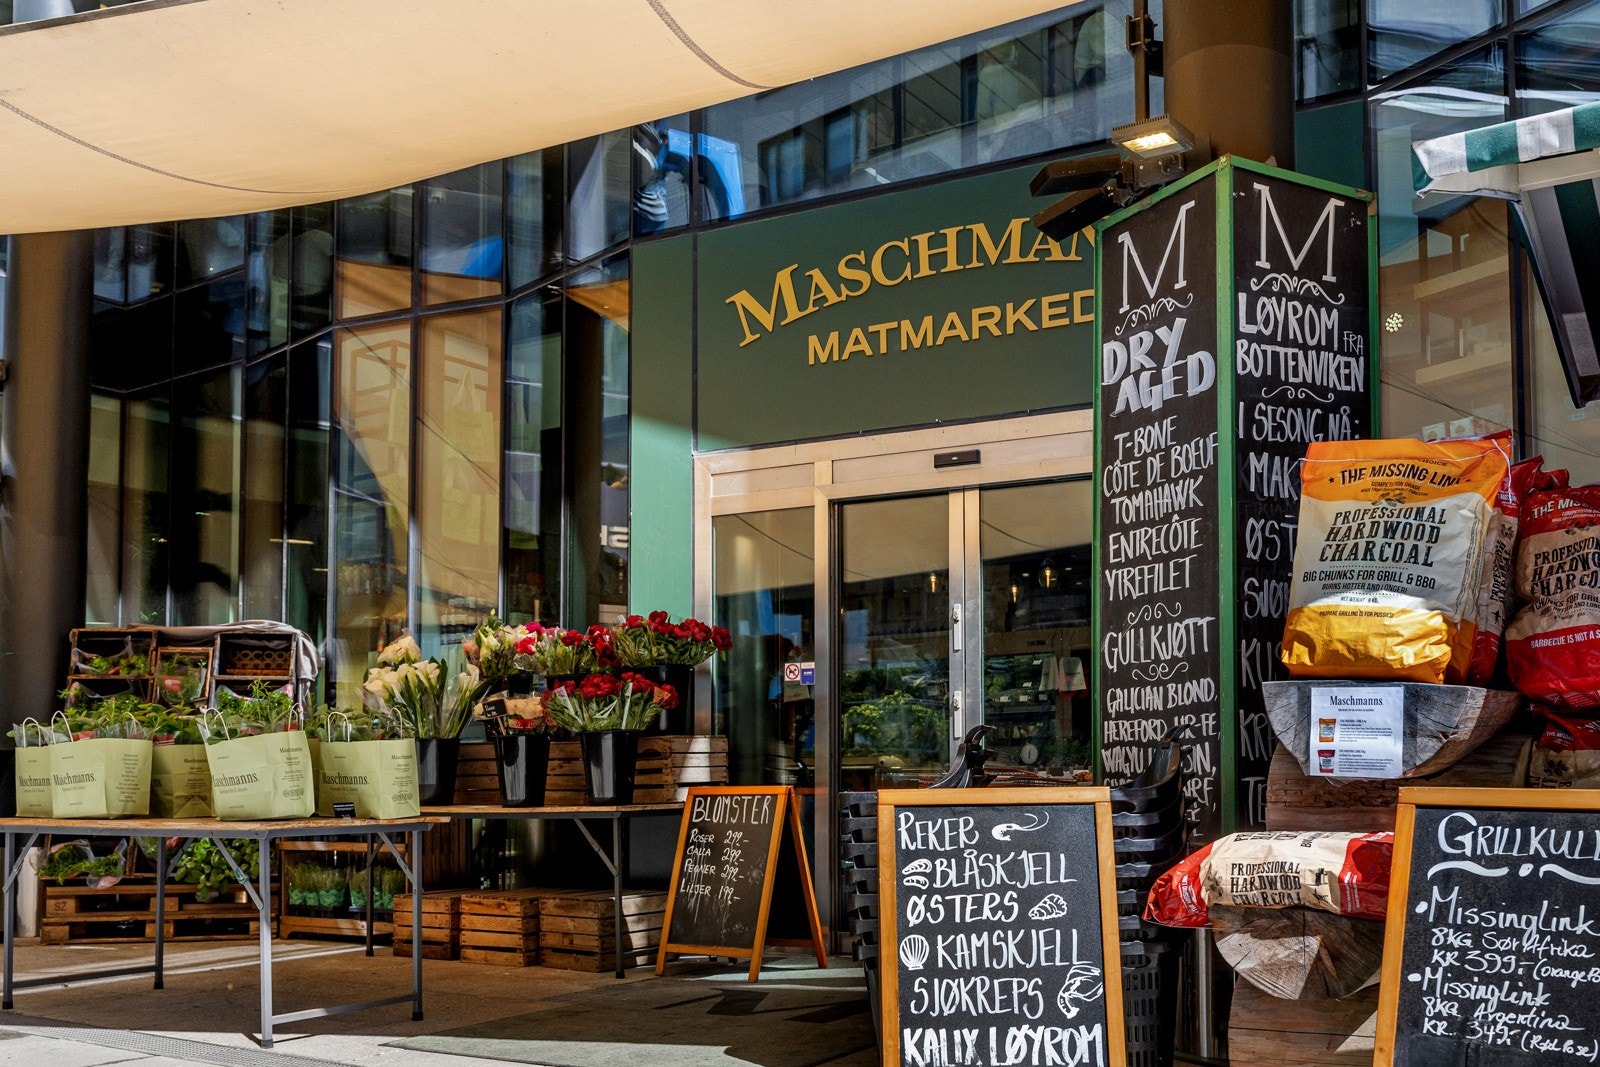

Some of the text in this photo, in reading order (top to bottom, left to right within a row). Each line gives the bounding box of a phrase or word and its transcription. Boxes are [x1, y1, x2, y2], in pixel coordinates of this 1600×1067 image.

[1253, 182, 1345, 282] M
[1118, 200, 1195, 314] M
[1238, 292, 1364, 356] LØYROM FRA
[1101, 317, 1187, 386] DRY
[1236, 339, 1364, 392] BOTTENVIKEN
[1110, 350, 1216, 418] AGED
[1114, 415, 1178, 460] T-BONE
[1252, 402, 1324, 442] SESONG
[1103, 432, 1219, 498] CÔTE DE BOEUF
[1249, 452, 1301, 501] MAK
[1340, 467, 1367, 486] THE
[1369, 463, 1429, 482] MISSING
[1110, 475, 1204, 524] TOMAHAWK
[1333, 505, 1447, 526] PROFESSIONAL
[1532, 500, 1555, 519] THE
[1109, 514, 1203, 563] ENTRECÔTE
[1324, 520, 1441, 545] HARDWOOD
[1319, 541, 1434, 567] CHARCOAL
[1105, 554, 1198, 602] YTREFILET
[1303, 569, 1437, 590] BIG CHUNKS FOR GRILL & BBQ
[1342, 582, 1366, 590] HOTTER
[1366, 583, 1380, 591] AND
[1381, 583, 1408, 593] LONGER!
[1104, 616, 1215, 672] GULLKJØTT
[1531, 635, 1566, 648] BARBECUE
[1567, 634, 1574, 644] IS
[1575, 632, 1588, 642] NOT
[1589, 630, 1595, 640] A
[1104, 718, 1168, 743] HEREFORD
[692, 795, 772, 825] BLOMSTER
[686, 845, 711, 856] CALLA
[689, 828, 714, 844] ROSER
[898, 811, 980, 851] REKER
[933, 849, 1077, 889] BLÅSKJELL
[1230, 874, 1302, 893] HARDWOOD
[1231, 861, 1301, 877] PROFESSIONAL
[906, 890, 1019, 927] ØSTERS
[937, 927, 1093, 970] KAMSKJELL
[910, 975, 1045, 1020] SJØKREPS
[1473, 1002, 1586, 1031] Argentina
[903, 1023, 1103, 1067] KALIX LØYROM
